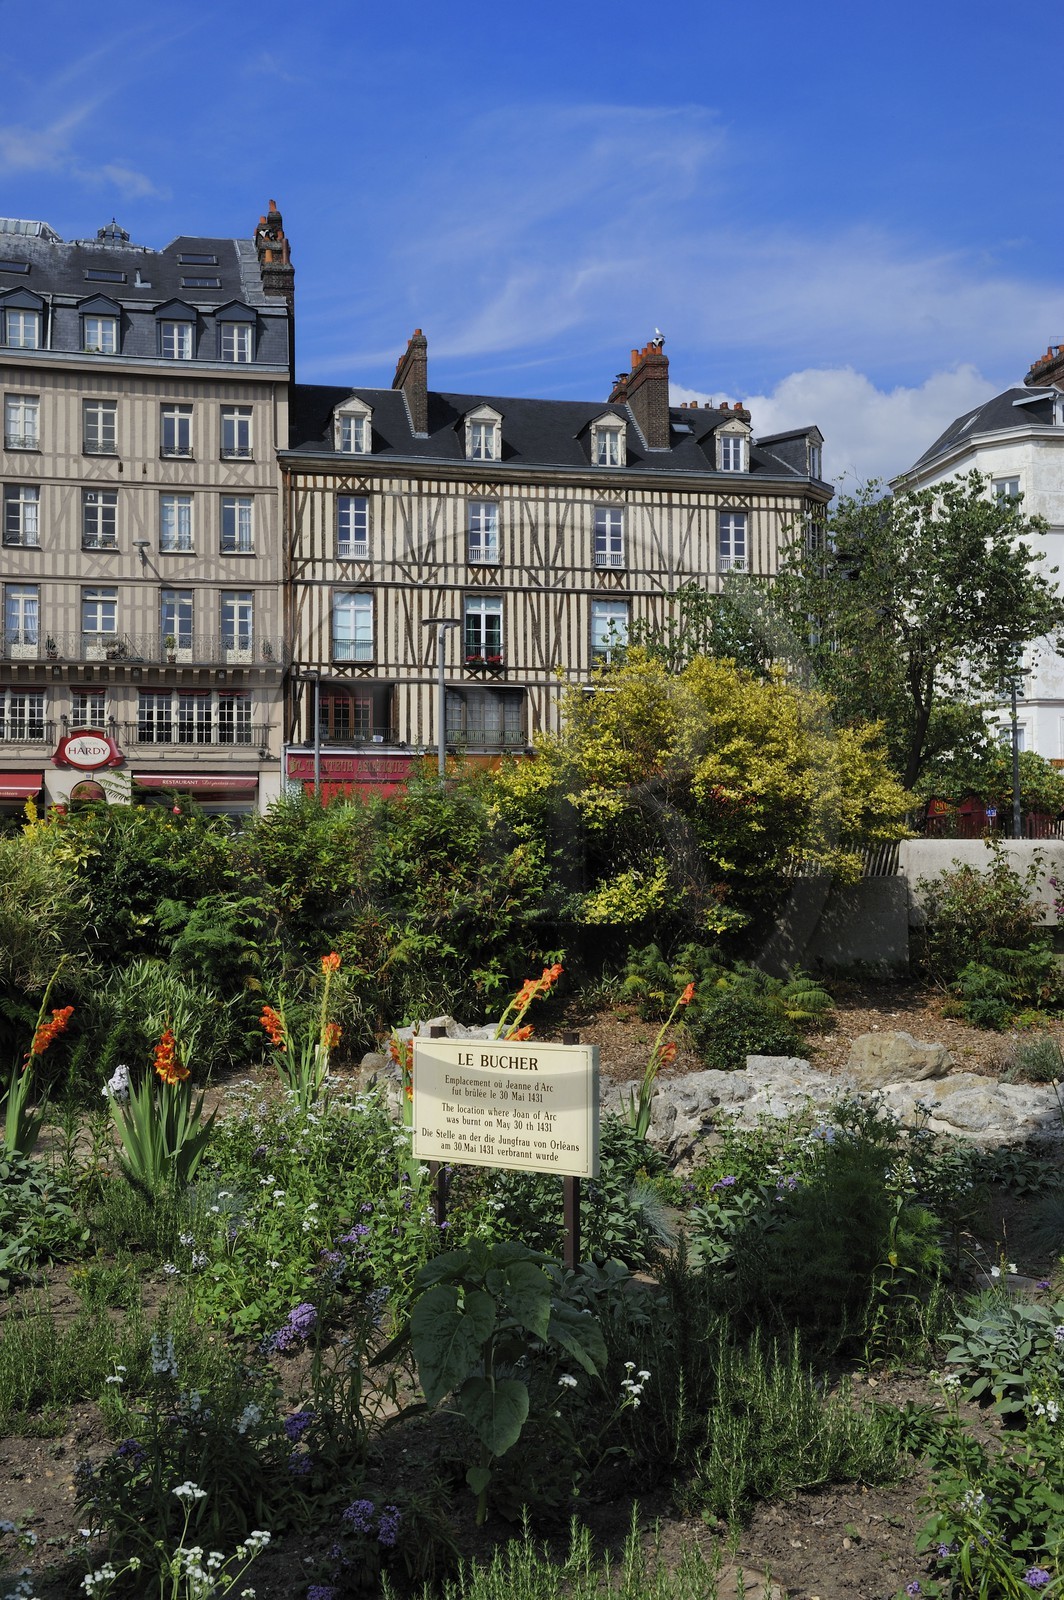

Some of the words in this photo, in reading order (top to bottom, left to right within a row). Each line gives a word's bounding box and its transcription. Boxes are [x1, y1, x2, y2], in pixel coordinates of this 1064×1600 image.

[68, 747, 108, 755] HARDY
[458, 1053, 474, 1066] LE
[480, 1054, 538, 1071] BUCHER
[445, 1074, 491, 1088] Emplacement
[493, 1079, 503, 1088] où
[505, 1080, 532, 1091] Jeanne
[534, 1082, 554, 1093] d'Arc
[452, 1087, 462, 1096] fut
[464, 1088, 487, 1098] brûlée
[490, 1090, 497, 1099] le
[499, 1090, 509, 1100] 30
[511, 1091, 525, 1101] Mai
[528, 1092, 543, 1103] 1431
[442, 1102, 455, 1112] The
[457, 1104, 485, 1115] location
[487, 1107, 510, 1117] where
[512, 1109, 530, 1119] Joan
[533, 1110, 541, 1120] of
[543, 1111, 557, 1121] Arc
[446, 1116, 460, 1124] was
[462, 1116, 481, 1126] burnt
[496, 1119, 511, 1131] May
[513, 1120, 523, 1130] 30
[526, 1121, 534, 1131] th
[537, 1122, 552, 1132] 1431
[421, 1127, 434, 1137] Die
[435, 1128, 456, 1139] Stelle
[458, 1133, 467, 1141] an
[469, 1132, 481, 1142] der
[484, 1134, 496, 1143] die
[498, 1135, 530, 1148] Jungfrau
[533, 1140, 547, 1149] von
[550, 1139, 580, 1152] Orléans
[480, 1145, 494, 1155] 1431
[497, 1147, 532, 1159] verbrannt
[535, 1152, 559, 1162] wurde
